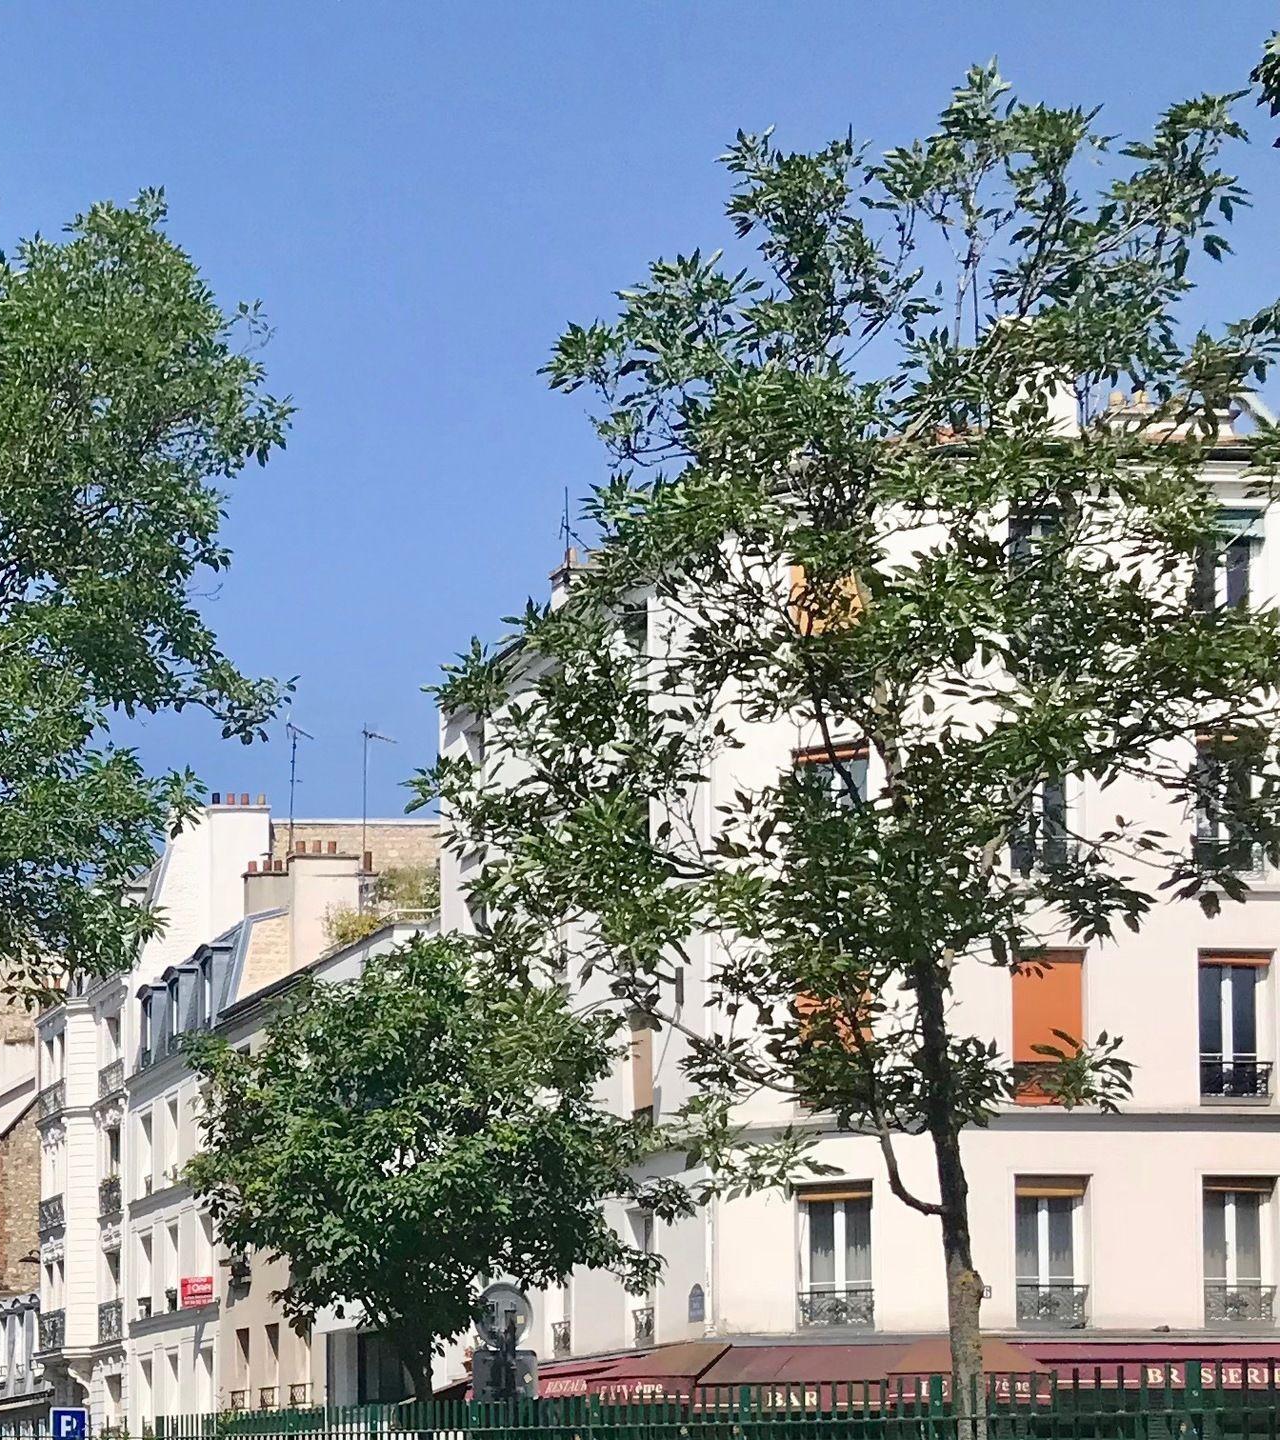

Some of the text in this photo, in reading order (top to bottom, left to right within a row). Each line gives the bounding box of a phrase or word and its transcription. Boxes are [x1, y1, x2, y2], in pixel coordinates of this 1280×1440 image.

[1146, 1368, 1280, 1383] BRSSERIE
[766, 1391, 817, 1407] BAR
[60, 1415, 78, 1438] P
